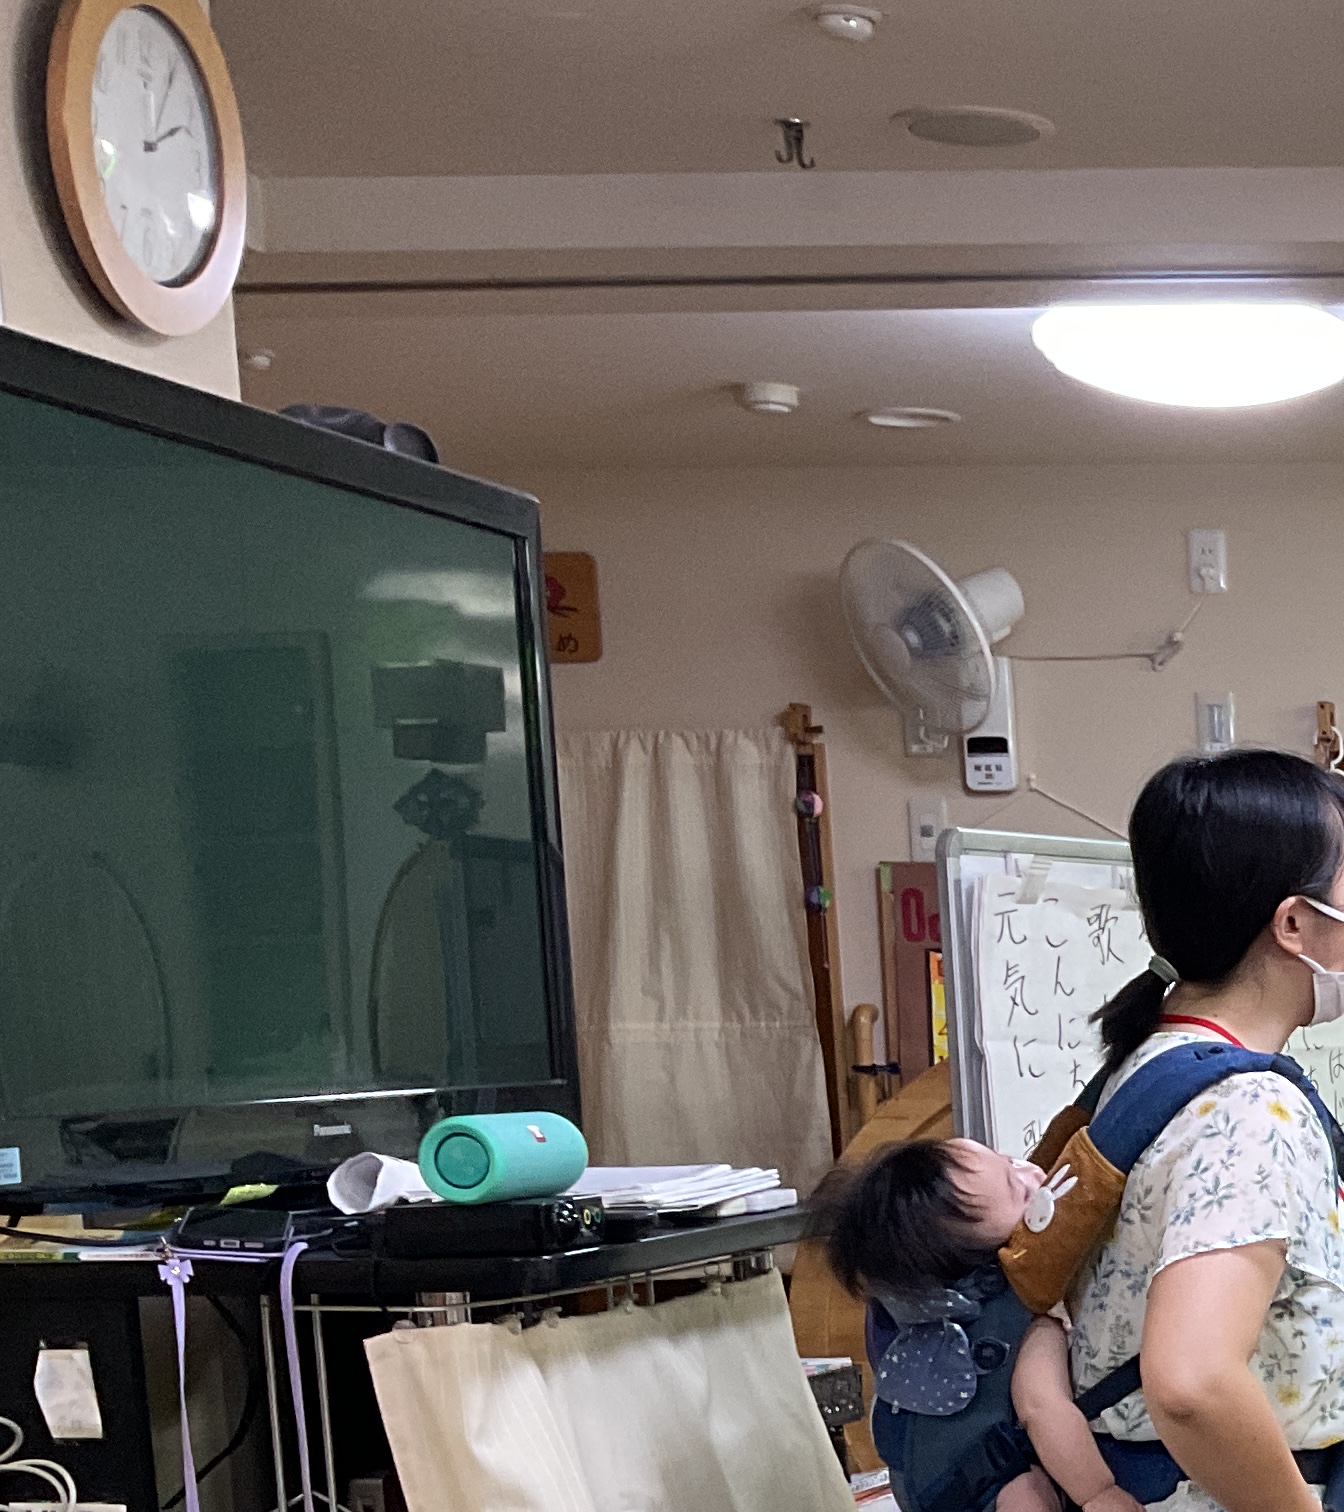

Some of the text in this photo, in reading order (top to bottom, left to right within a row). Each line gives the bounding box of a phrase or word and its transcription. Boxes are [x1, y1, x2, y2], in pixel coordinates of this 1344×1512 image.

[557, 631, 579, 654] め
[1086, 903, 1125, 966] 歌
[993, 891, 1047, 1078] 元気に
